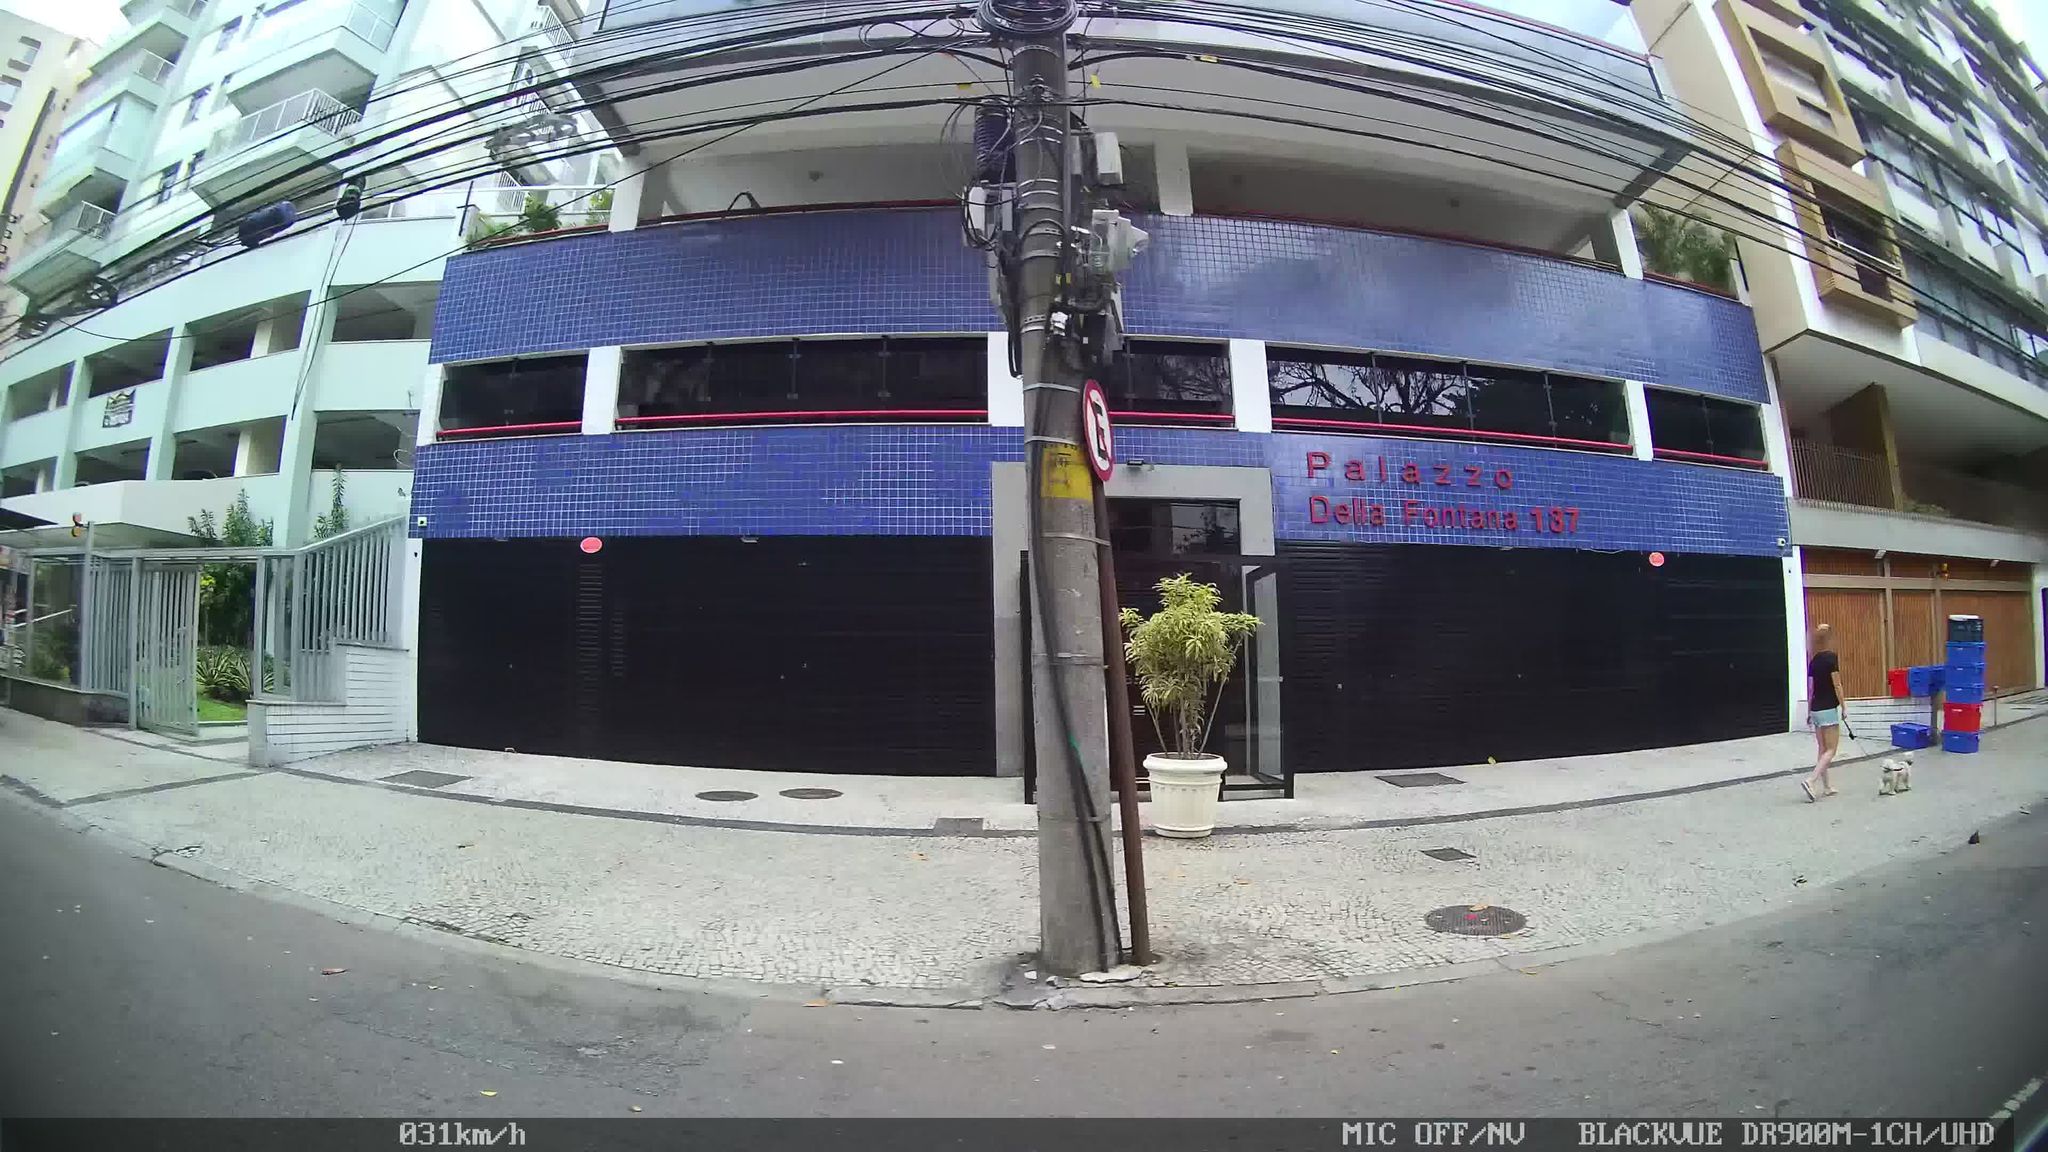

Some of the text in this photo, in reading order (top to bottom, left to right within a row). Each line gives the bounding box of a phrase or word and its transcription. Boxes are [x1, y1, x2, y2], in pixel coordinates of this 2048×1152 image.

[1306, 451, 1514, 490] Palazzo
[1309, 495, 1386, 527] Della
[1403, 499, 1518, 532] Fontana
